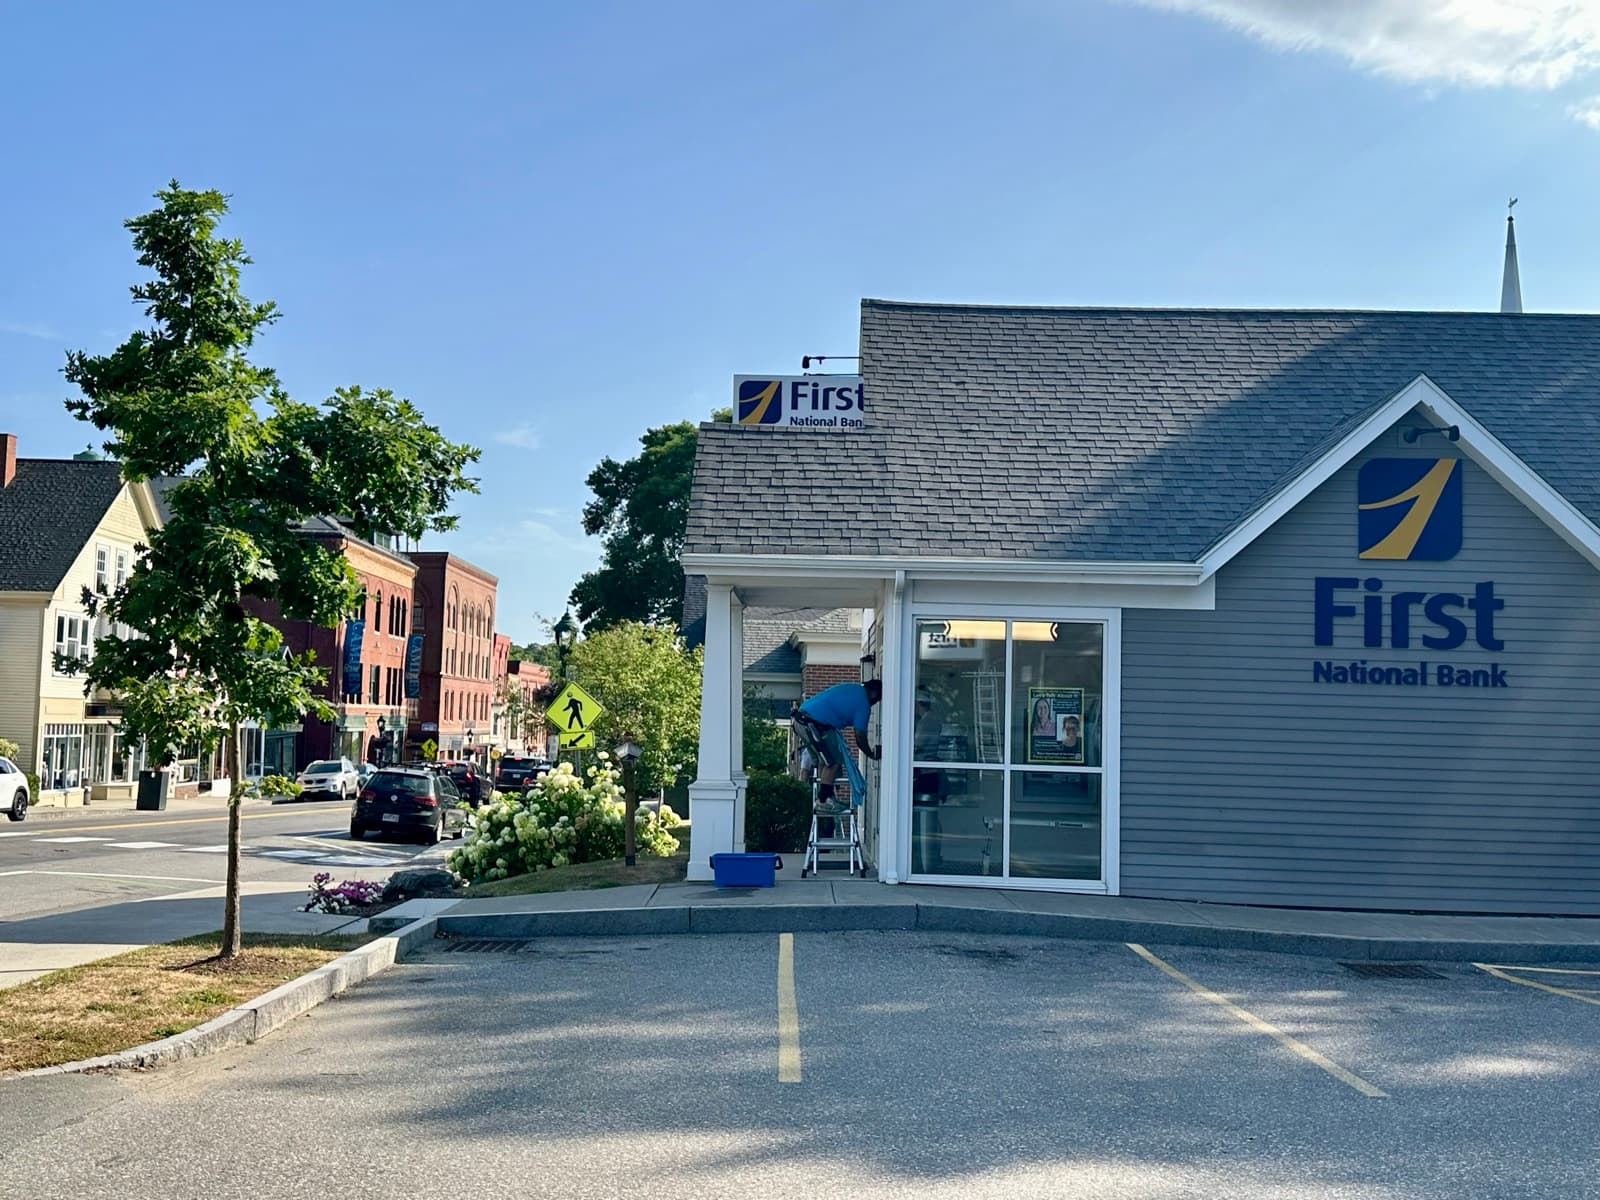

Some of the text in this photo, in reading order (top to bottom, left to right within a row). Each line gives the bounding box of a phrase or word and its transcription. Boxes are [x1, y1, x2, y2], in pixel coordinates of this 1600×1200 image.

[791, 381, 864, 411] First
[790, 416, 837, 427] National
[1314, 576, 1505, 651] First
[1313, 660, 1509, 688] National Bank
